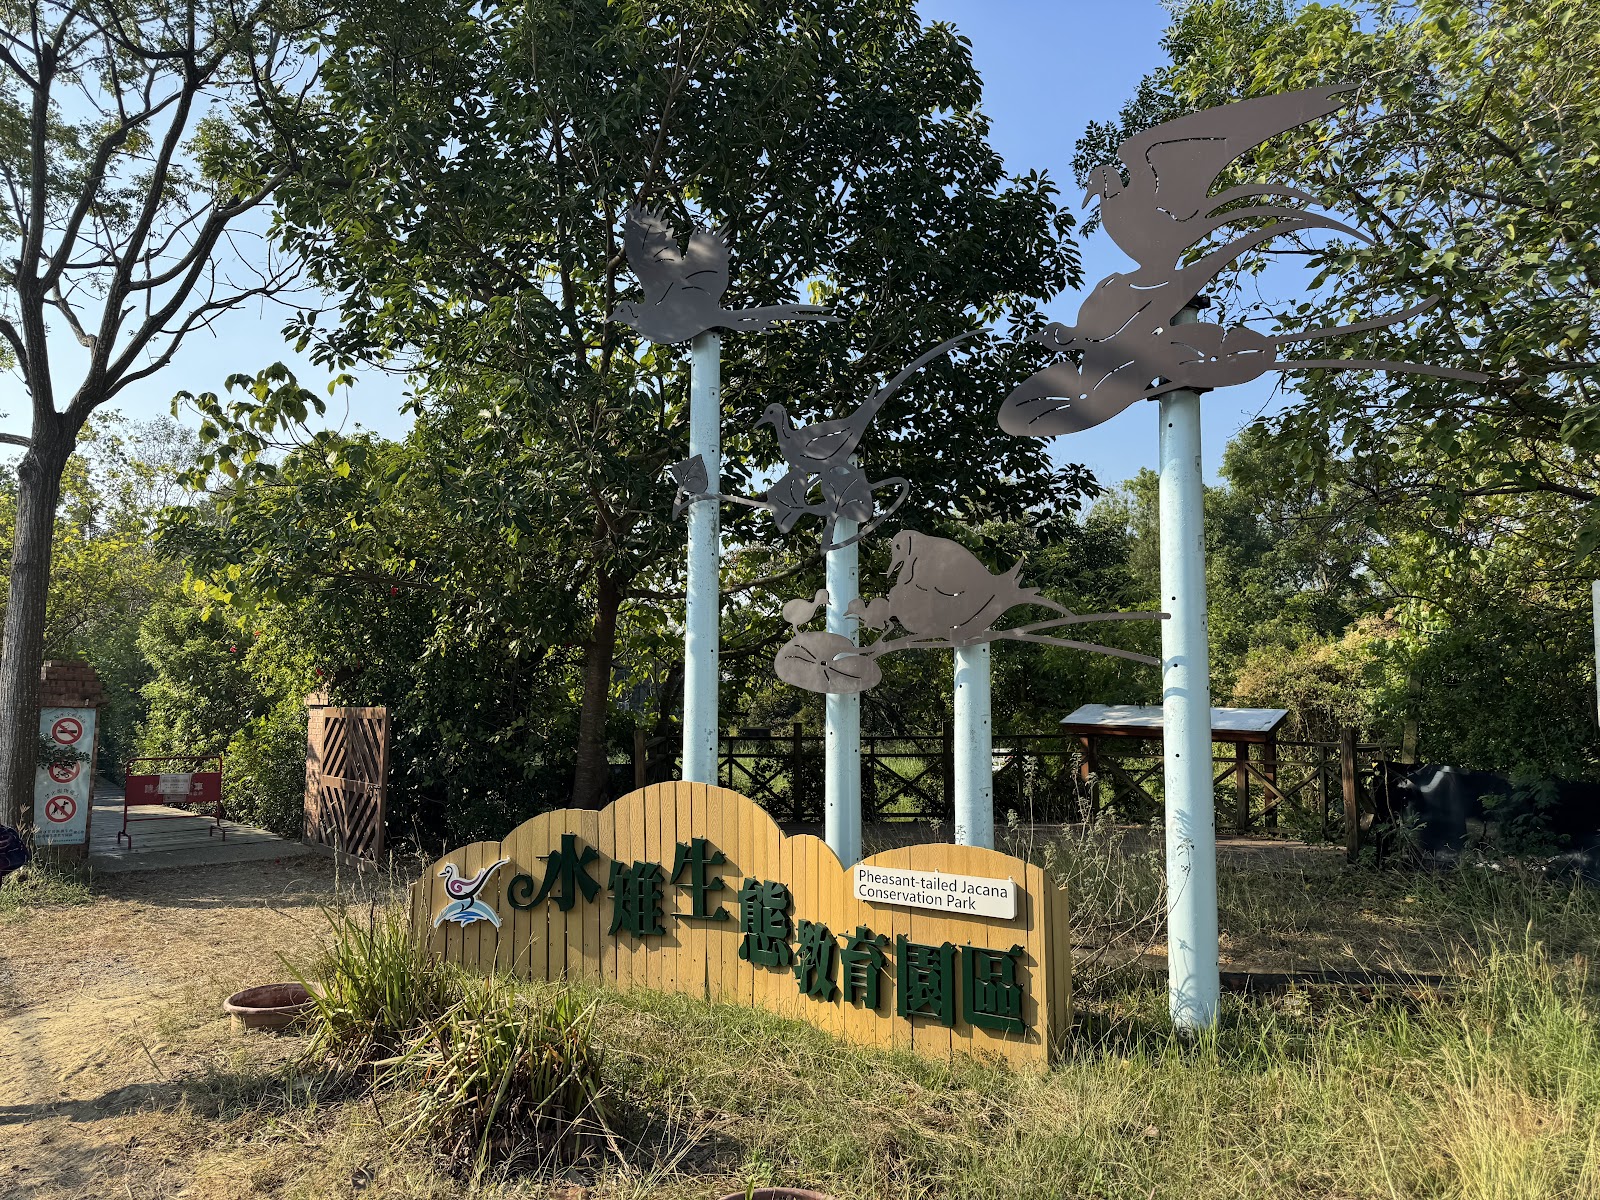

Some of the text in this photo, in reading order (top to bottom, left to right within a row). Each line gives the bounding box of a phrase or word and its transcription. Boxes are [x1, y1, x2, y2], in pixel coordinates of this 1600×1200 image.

[858, 869, 1008, 899] Pheasant-tailed Jacana
[858, 884, 976, 910] Conservation Park
[507, 833, 1024, 1035] 水雉生態教育園區
